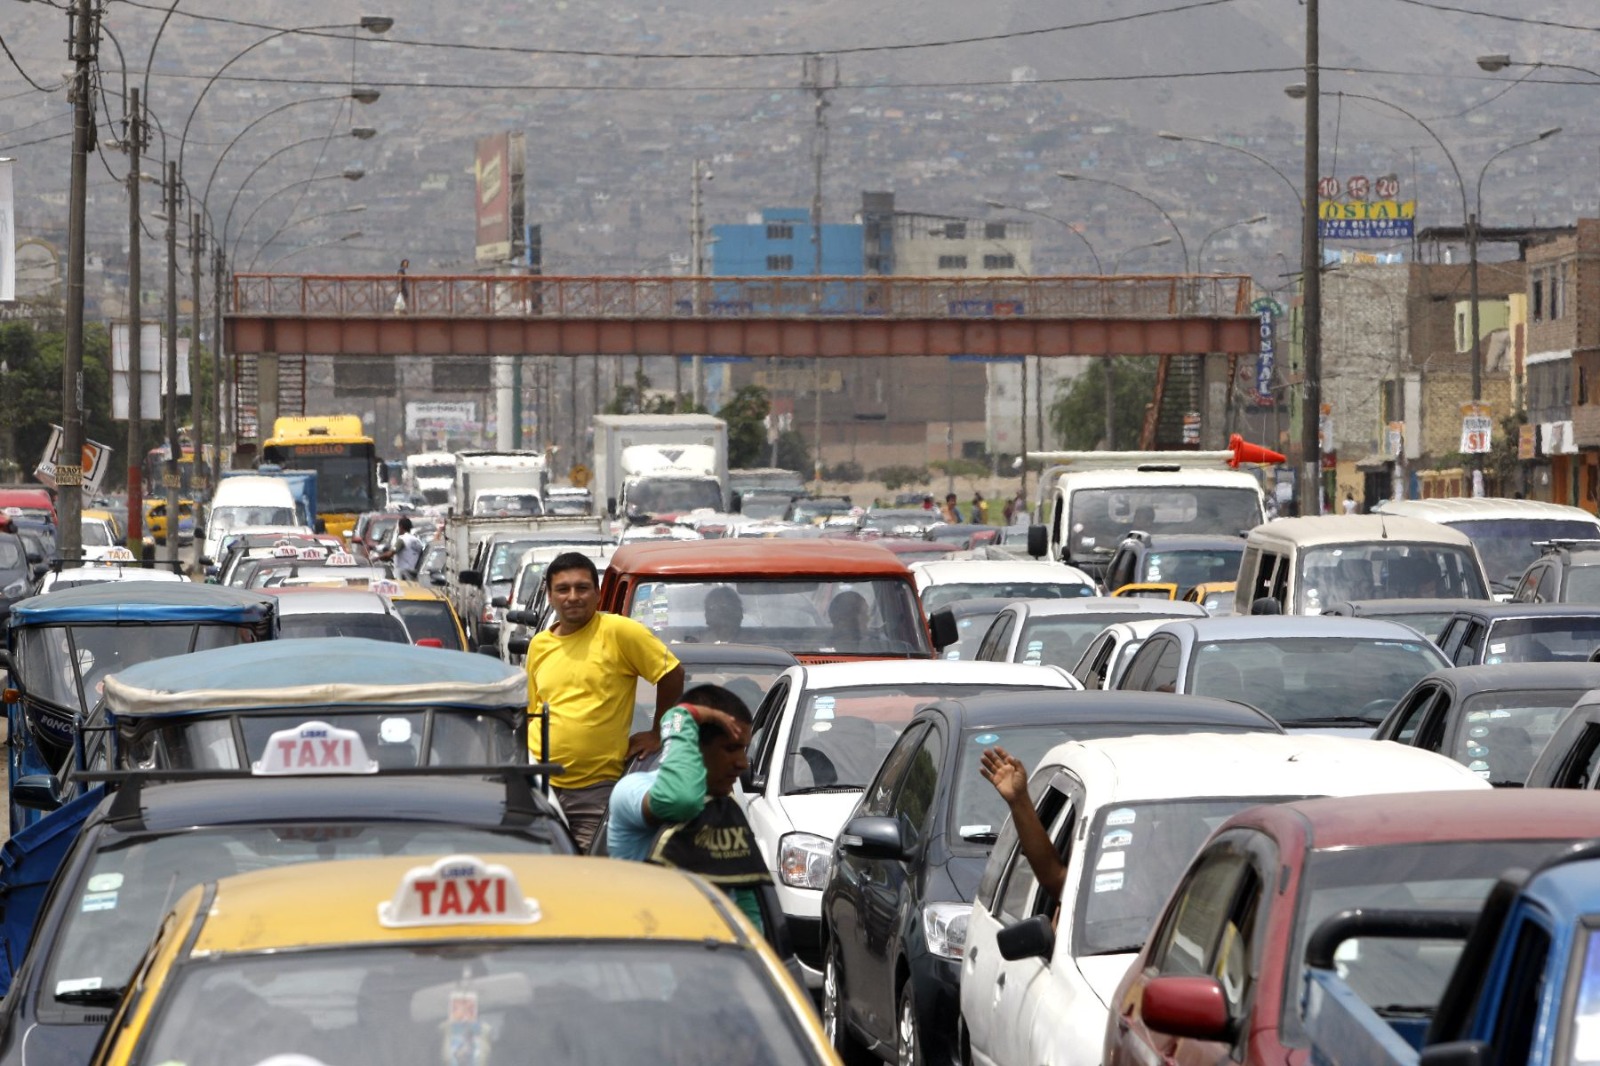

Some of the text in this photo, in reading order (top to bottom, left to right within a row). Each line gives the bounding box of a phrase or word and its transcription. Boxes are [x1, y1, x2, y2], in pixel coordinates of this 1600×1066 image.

[1320, 178, 1338, 196] 10
[1380, 178, 1398, 196] 20
[1325, 203, 1410, 219] OSTAL
[56, 466, 82, 477] TAROT
[107, 550, 130, 560] TAXI
[302, 550, 320, 559] TAXI
[331, 555, 353, 565] TAXI
[373, 584, 398, 595] TAXI
[300, 730, 327, 739] LIBRE
[278, 739, 352, 769] TAXI
[440, 866, 475, 879] LIBRE
[413, 877, 507, 916] TAXI
